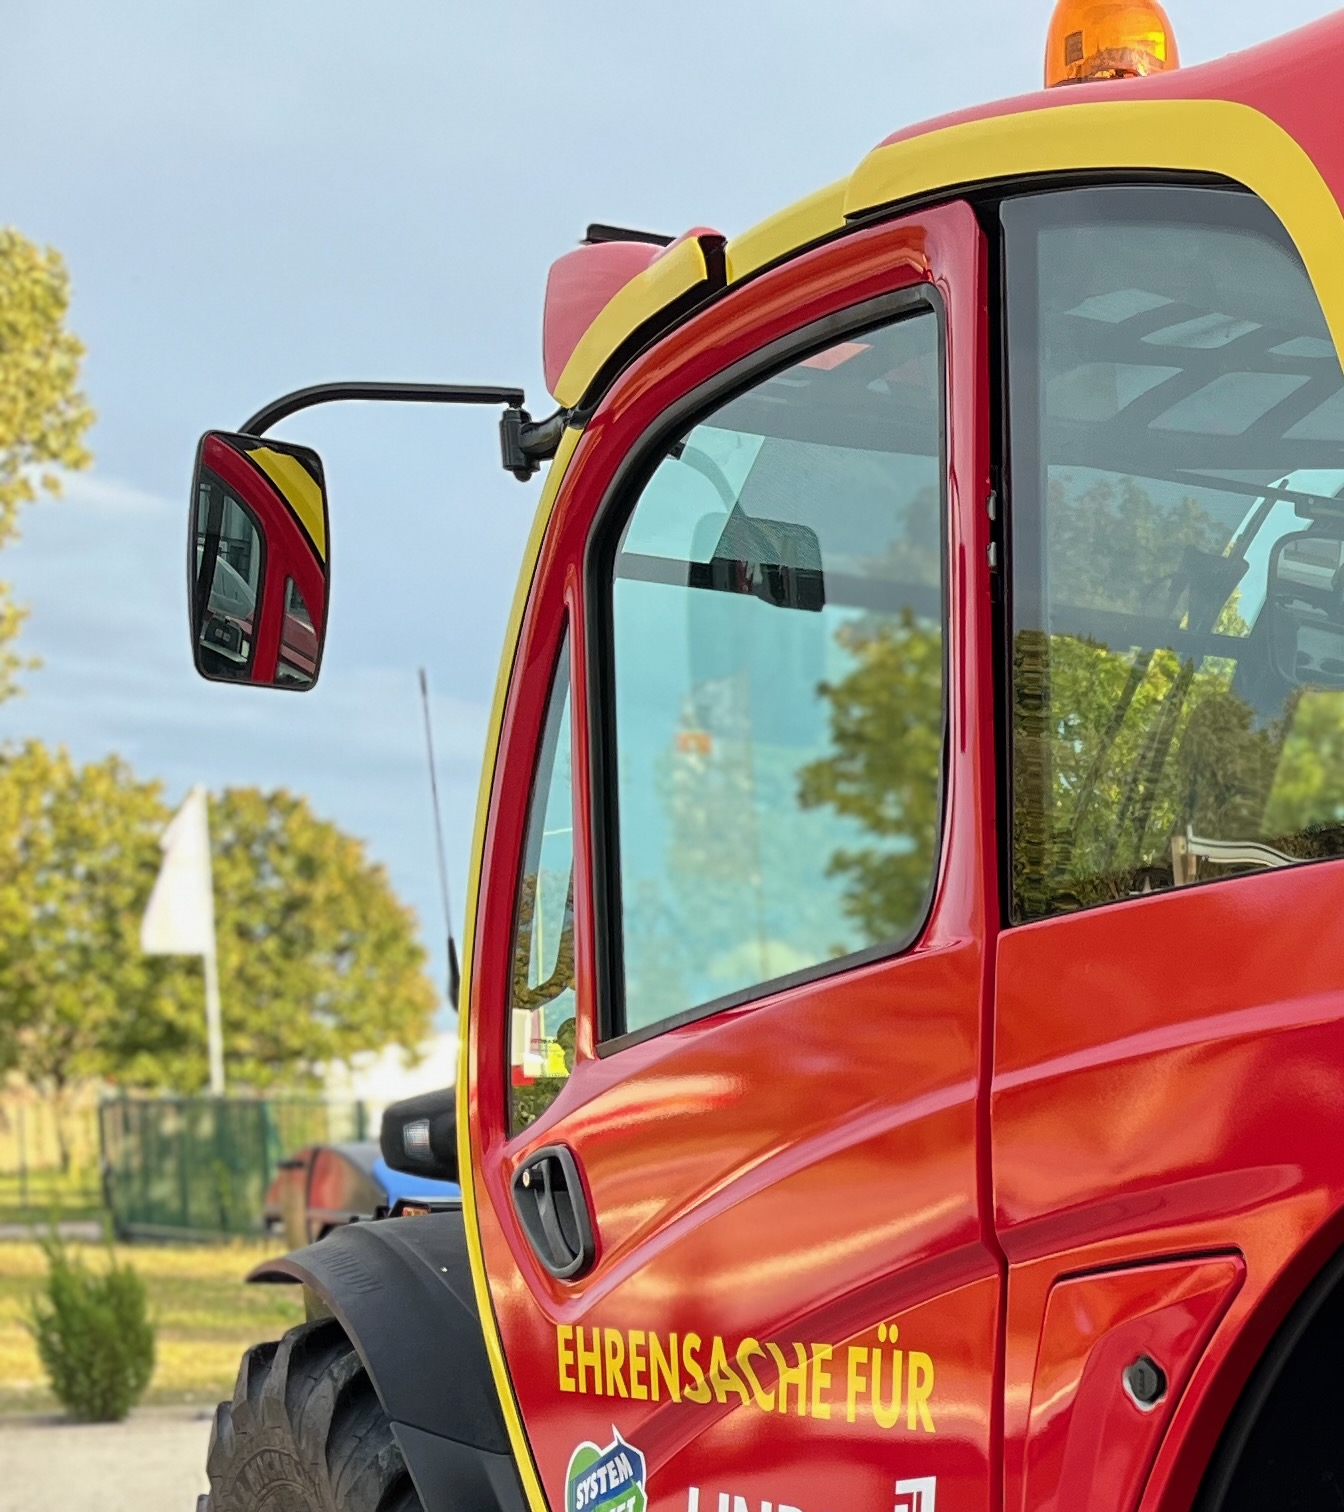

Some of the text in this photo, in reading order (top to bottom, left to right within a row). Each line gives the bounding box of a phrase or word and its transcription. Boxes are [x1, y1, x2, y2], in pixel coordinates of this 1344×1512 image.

[556, 1323, 936, 1433] EHRENSACHE FÜR
[575, 1453, 634, 1510] SYSTEM
